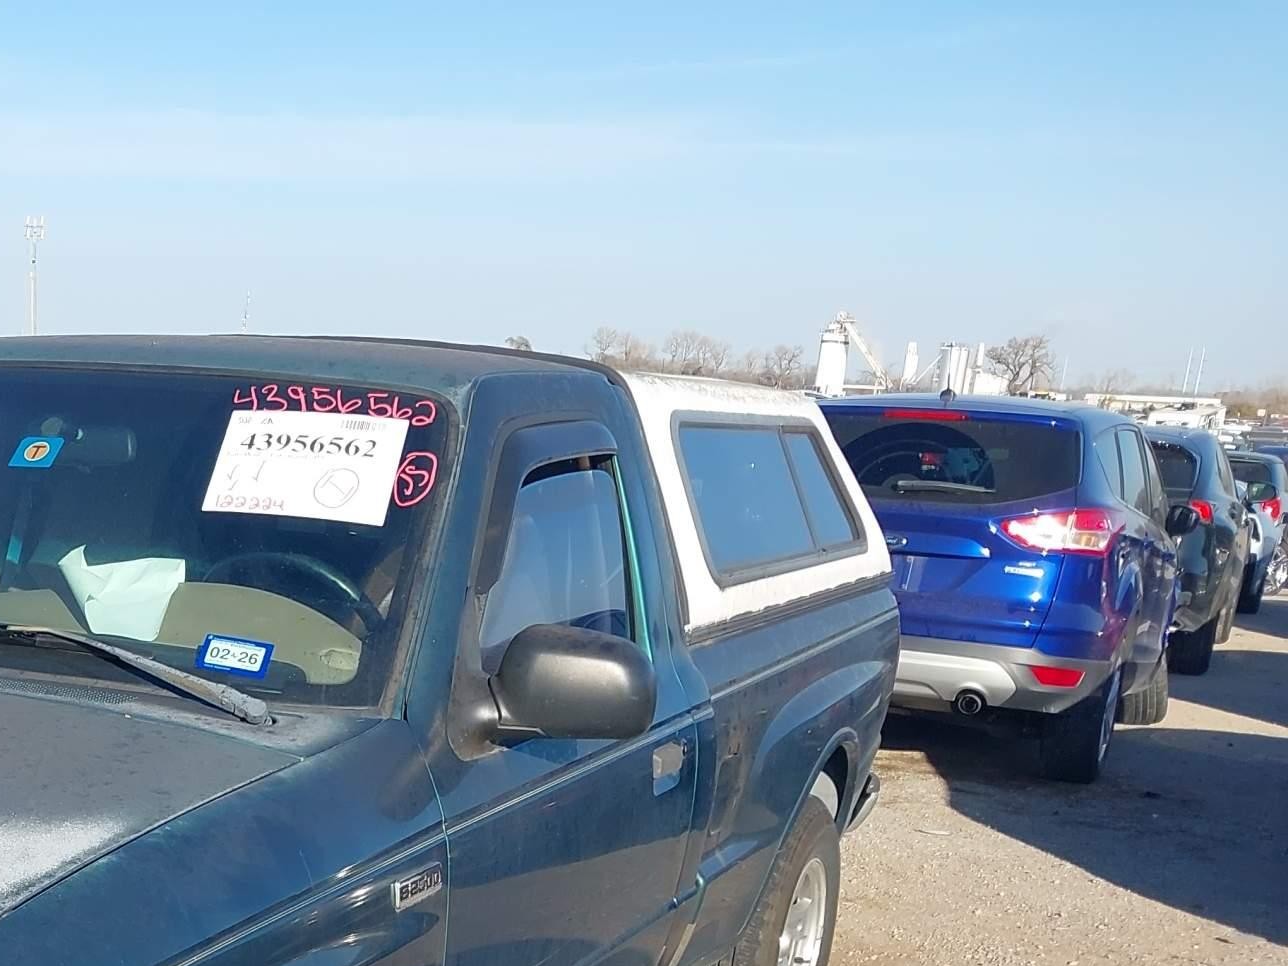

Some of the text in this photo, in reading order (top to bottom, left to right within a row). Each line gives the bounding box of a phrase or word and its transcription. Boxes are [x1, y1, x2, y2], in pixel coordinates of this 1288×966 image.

[233, 384, 436, 426] 43956562
[32, 445, 47, 459] T
[240, 433, 377, 458] 43956562
